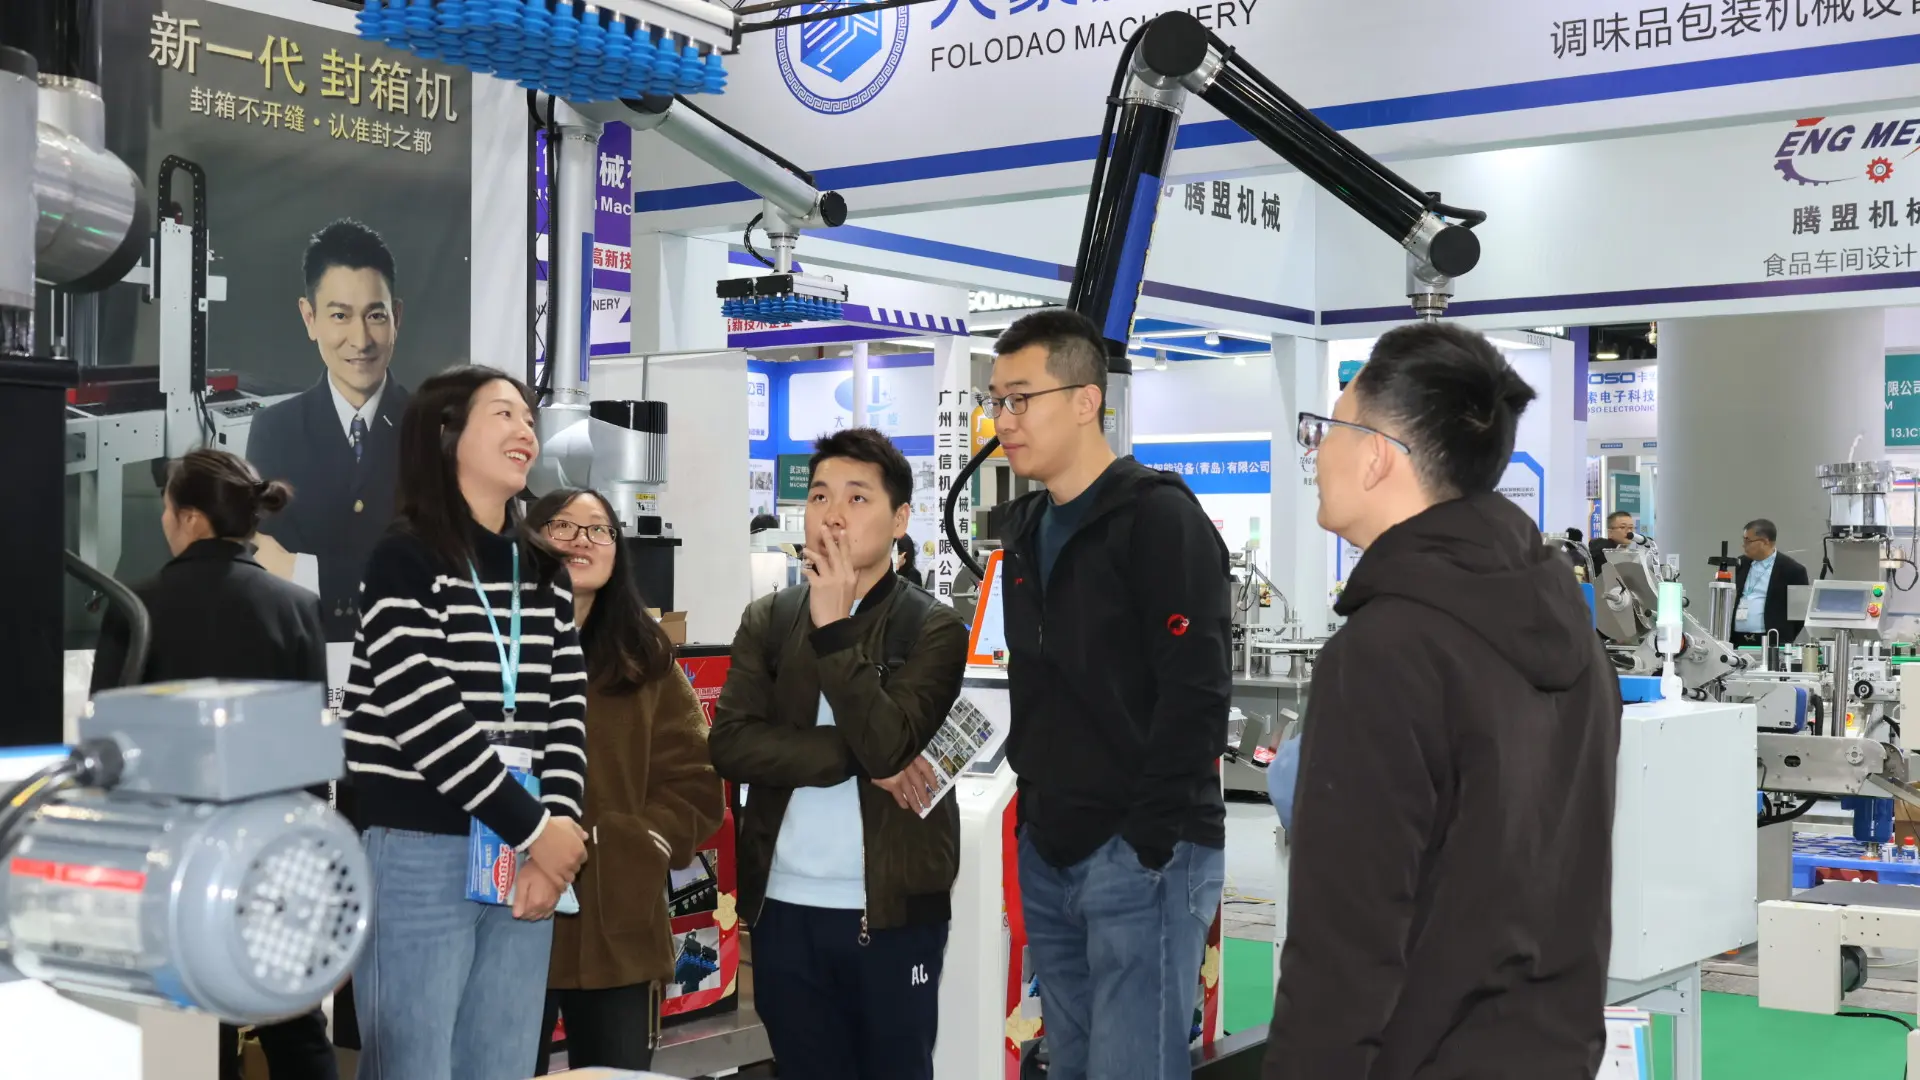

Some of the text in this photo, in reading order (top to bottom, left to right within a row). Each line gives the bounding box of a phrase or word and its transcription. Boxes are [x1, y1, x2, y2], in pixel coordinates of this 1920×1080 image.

[930, 28, 1065, 72] FOLODAO
[1074, 0, 1256, 50] MACERY
[149, 11, 459, 122] 新一代 封箱机
[1861, 119, 1920, 149] ME
[1184, 180, 1281, 232] 腾盟机械
[1763, 243, 1918, 278] 食品车间设计
